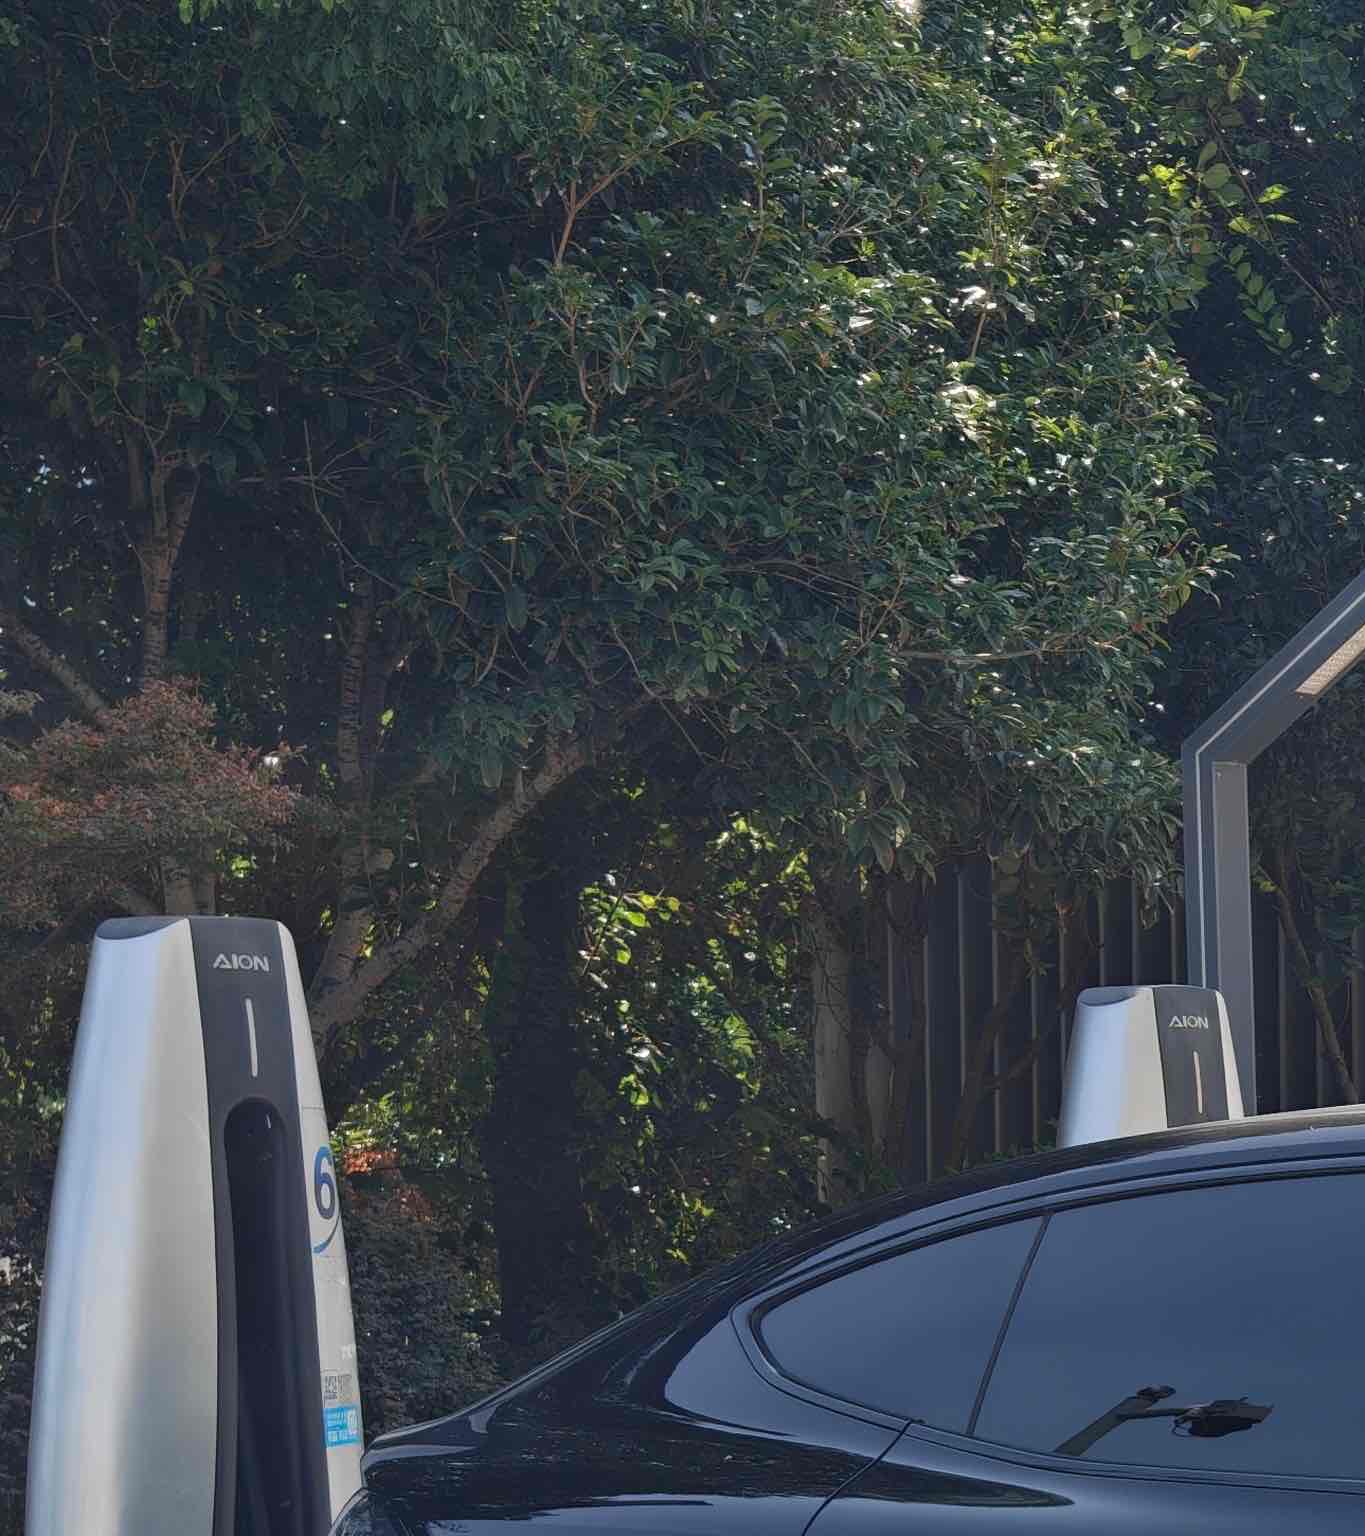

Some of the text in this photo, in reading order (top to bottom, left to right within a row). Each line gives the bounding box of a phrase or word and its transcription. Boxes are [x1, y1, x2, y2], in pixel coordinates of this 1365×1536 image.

[213, 953, 270, 972] AION
[1168, 1015, 1209, 1029] AION
[314, 1145, 337, 1220] 6
